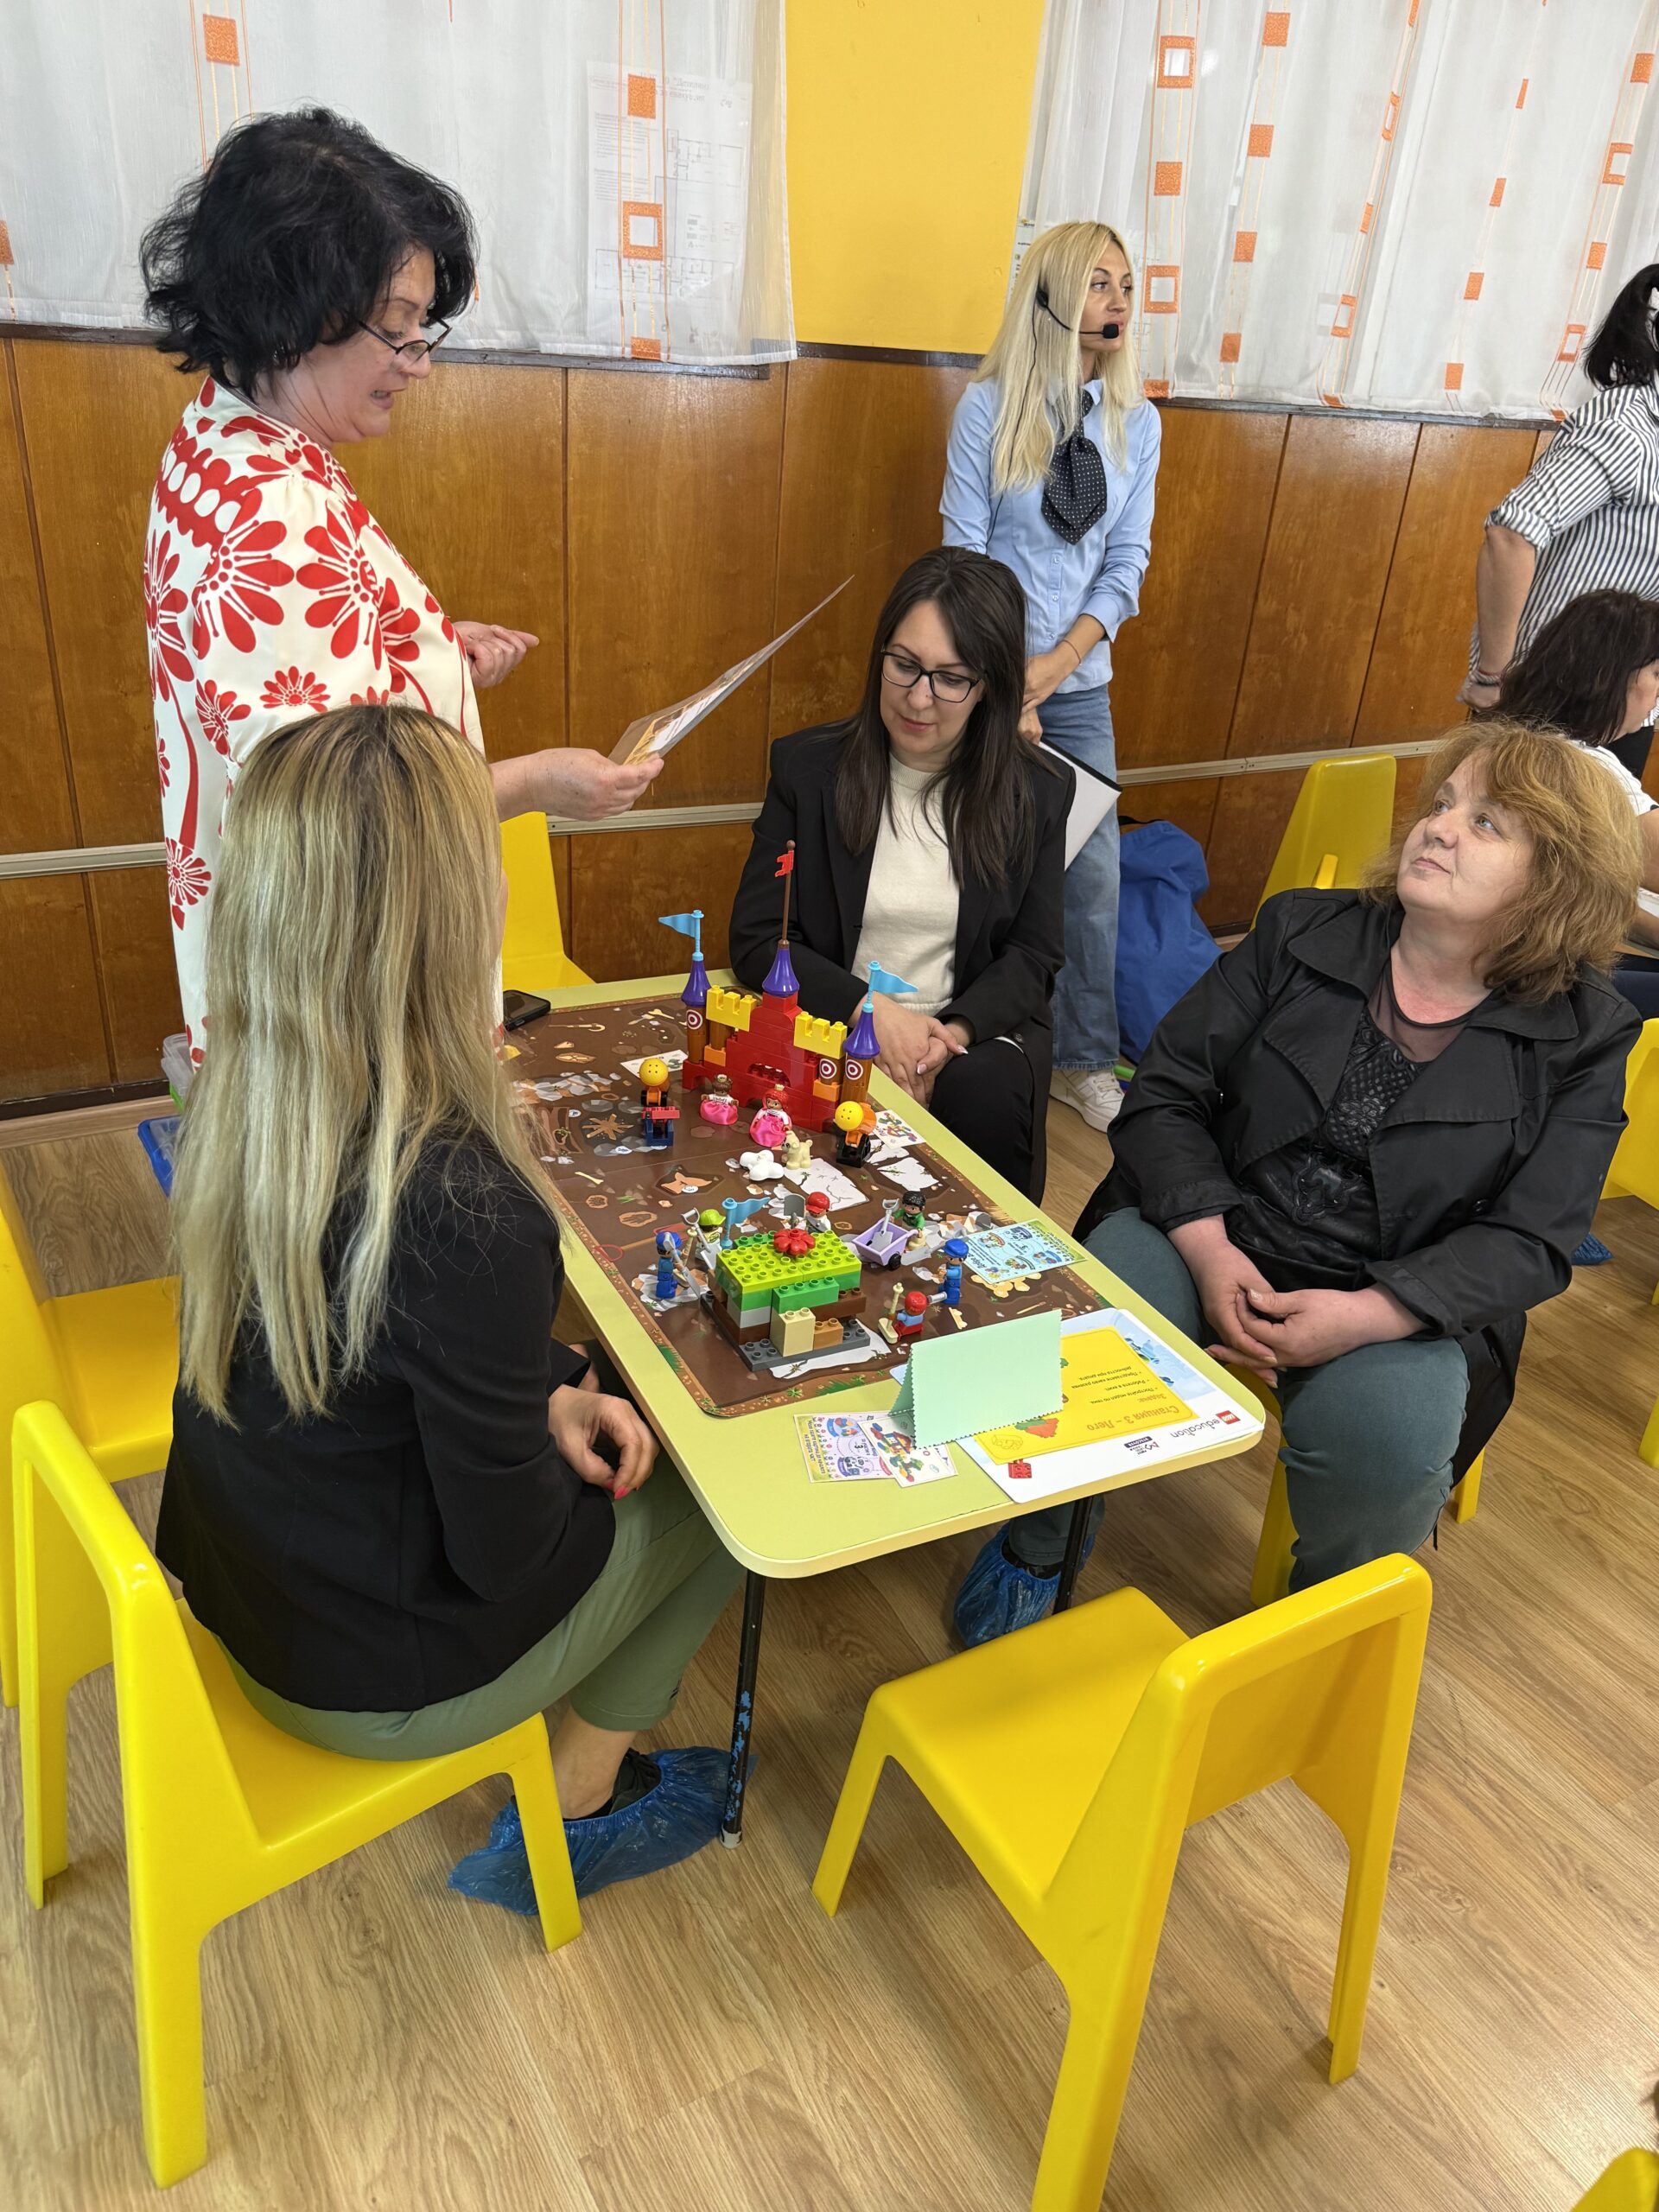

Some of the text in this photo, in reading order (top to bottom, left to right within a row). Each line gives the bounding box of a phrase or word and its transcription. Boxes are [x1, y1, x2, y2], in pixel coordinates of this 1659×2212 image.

[1133, 1405, 1179, 1420] Станция
[1123, 1415, 1134, 1424] 3
[1087, 1420, 1115, 1431] Лего
[1170, 1418, 1220, 1438] education
[1128, 1437, 1149, 1446] DISCOVER
